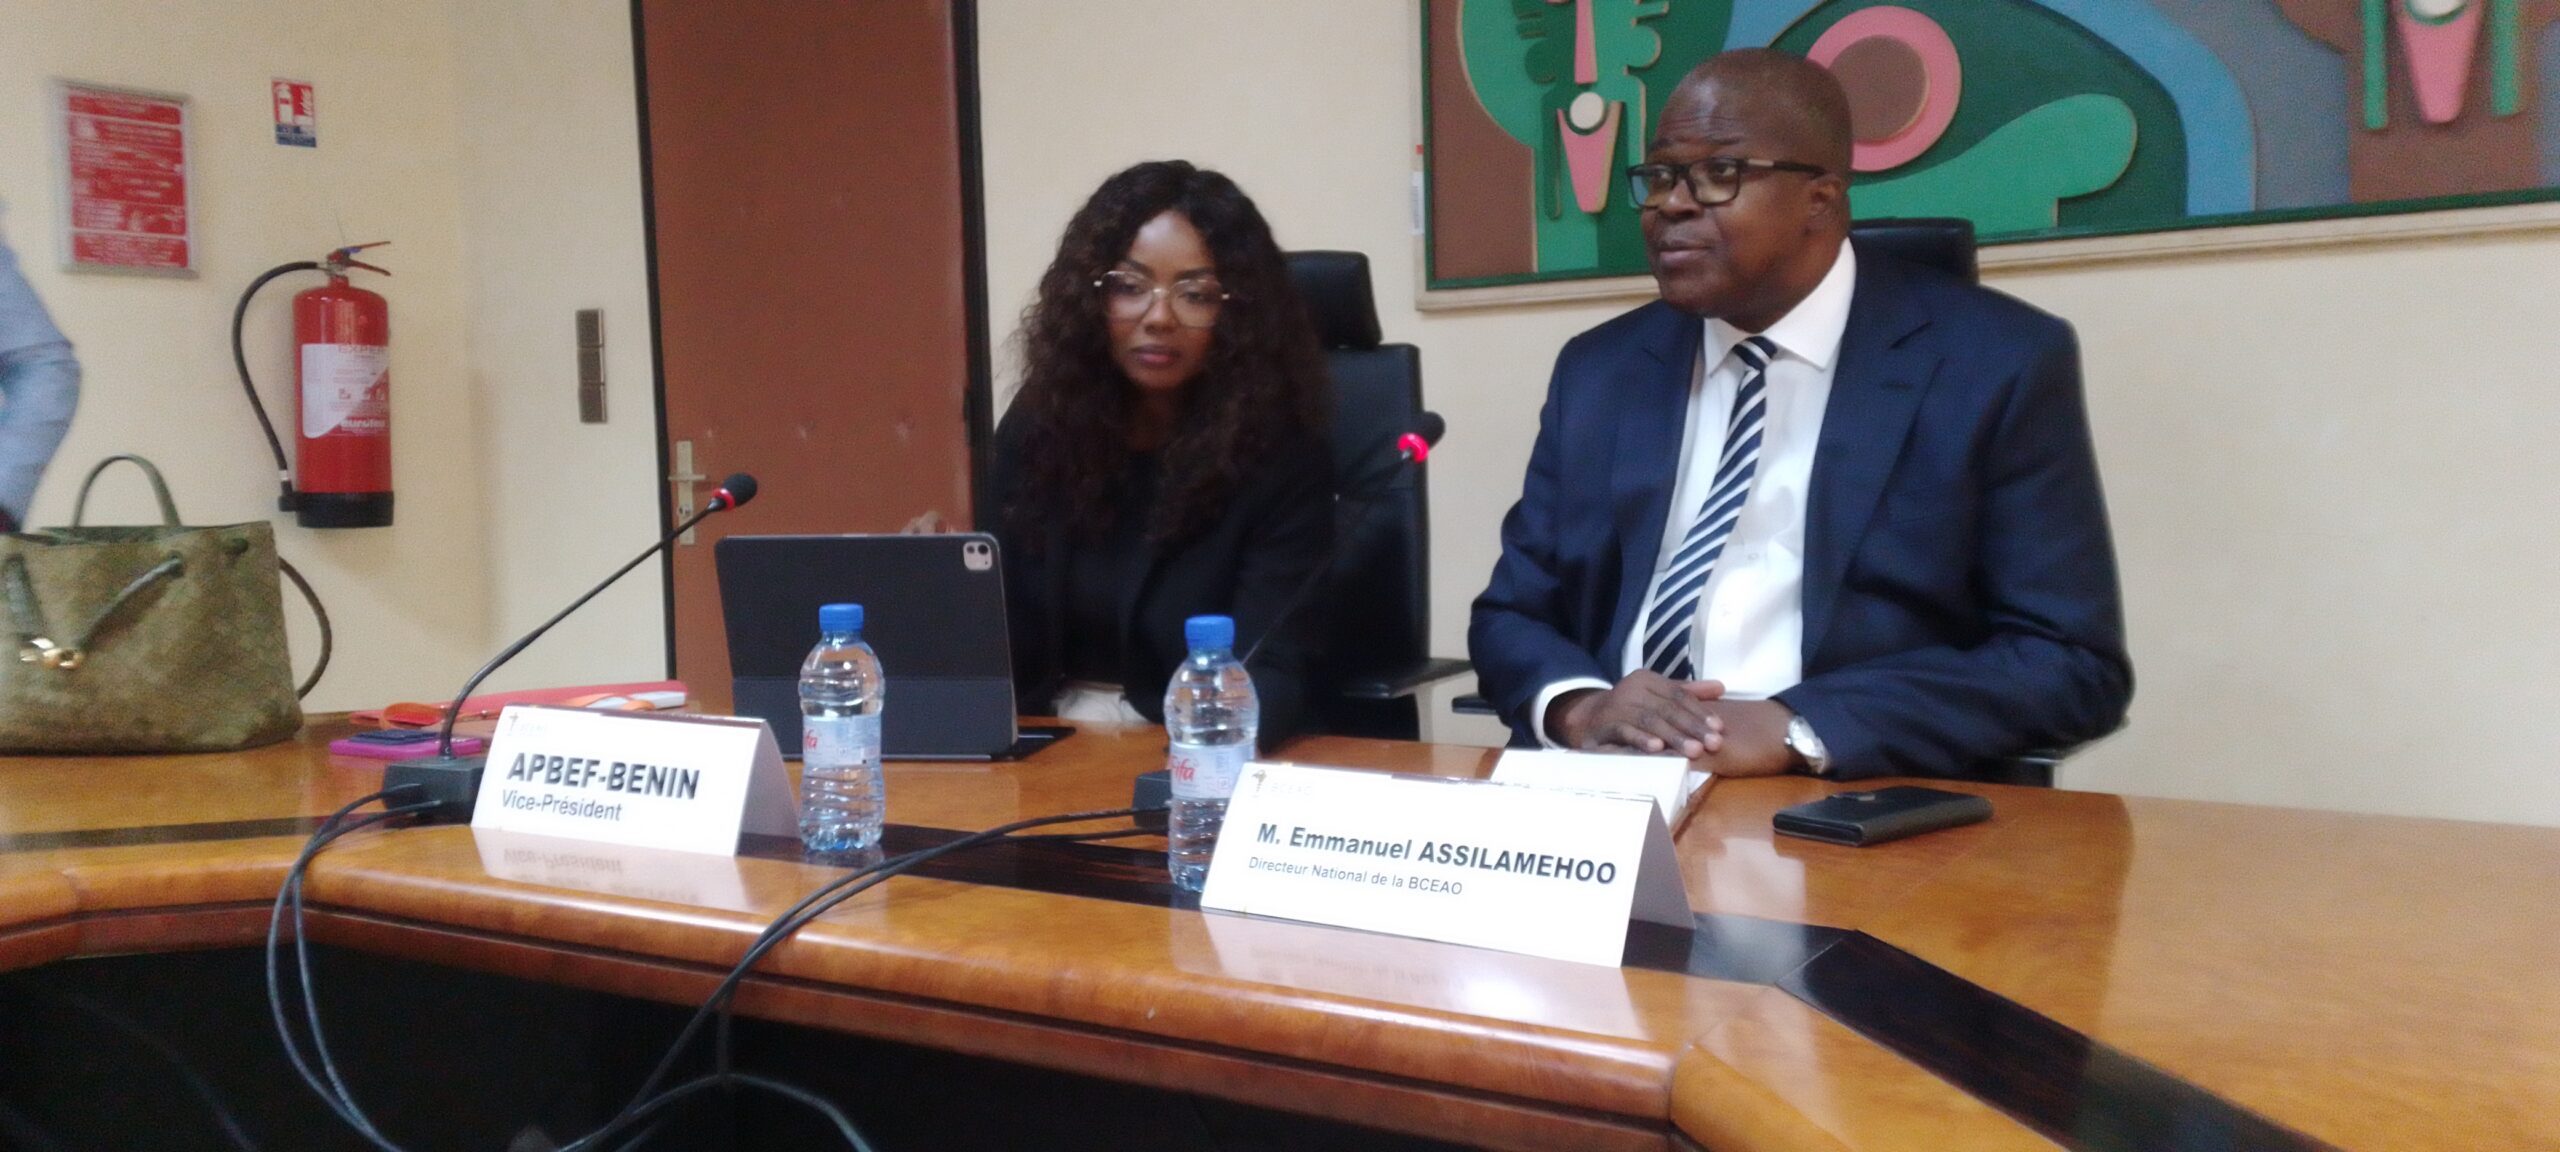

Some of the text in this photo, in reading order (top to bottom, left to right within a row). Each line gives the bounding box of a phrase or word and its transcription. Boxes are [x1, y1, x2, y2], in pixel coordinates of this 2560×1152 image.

[506, 752, 700, 800] APBEF-BENIN
[501, 789, 623, 821] Vice-Président
[1248, 856, 1463, 895] Directeur National de la BCEAO
[1256, 823, 1616, 885] M. Emmanuel ASSILAMEHOO
